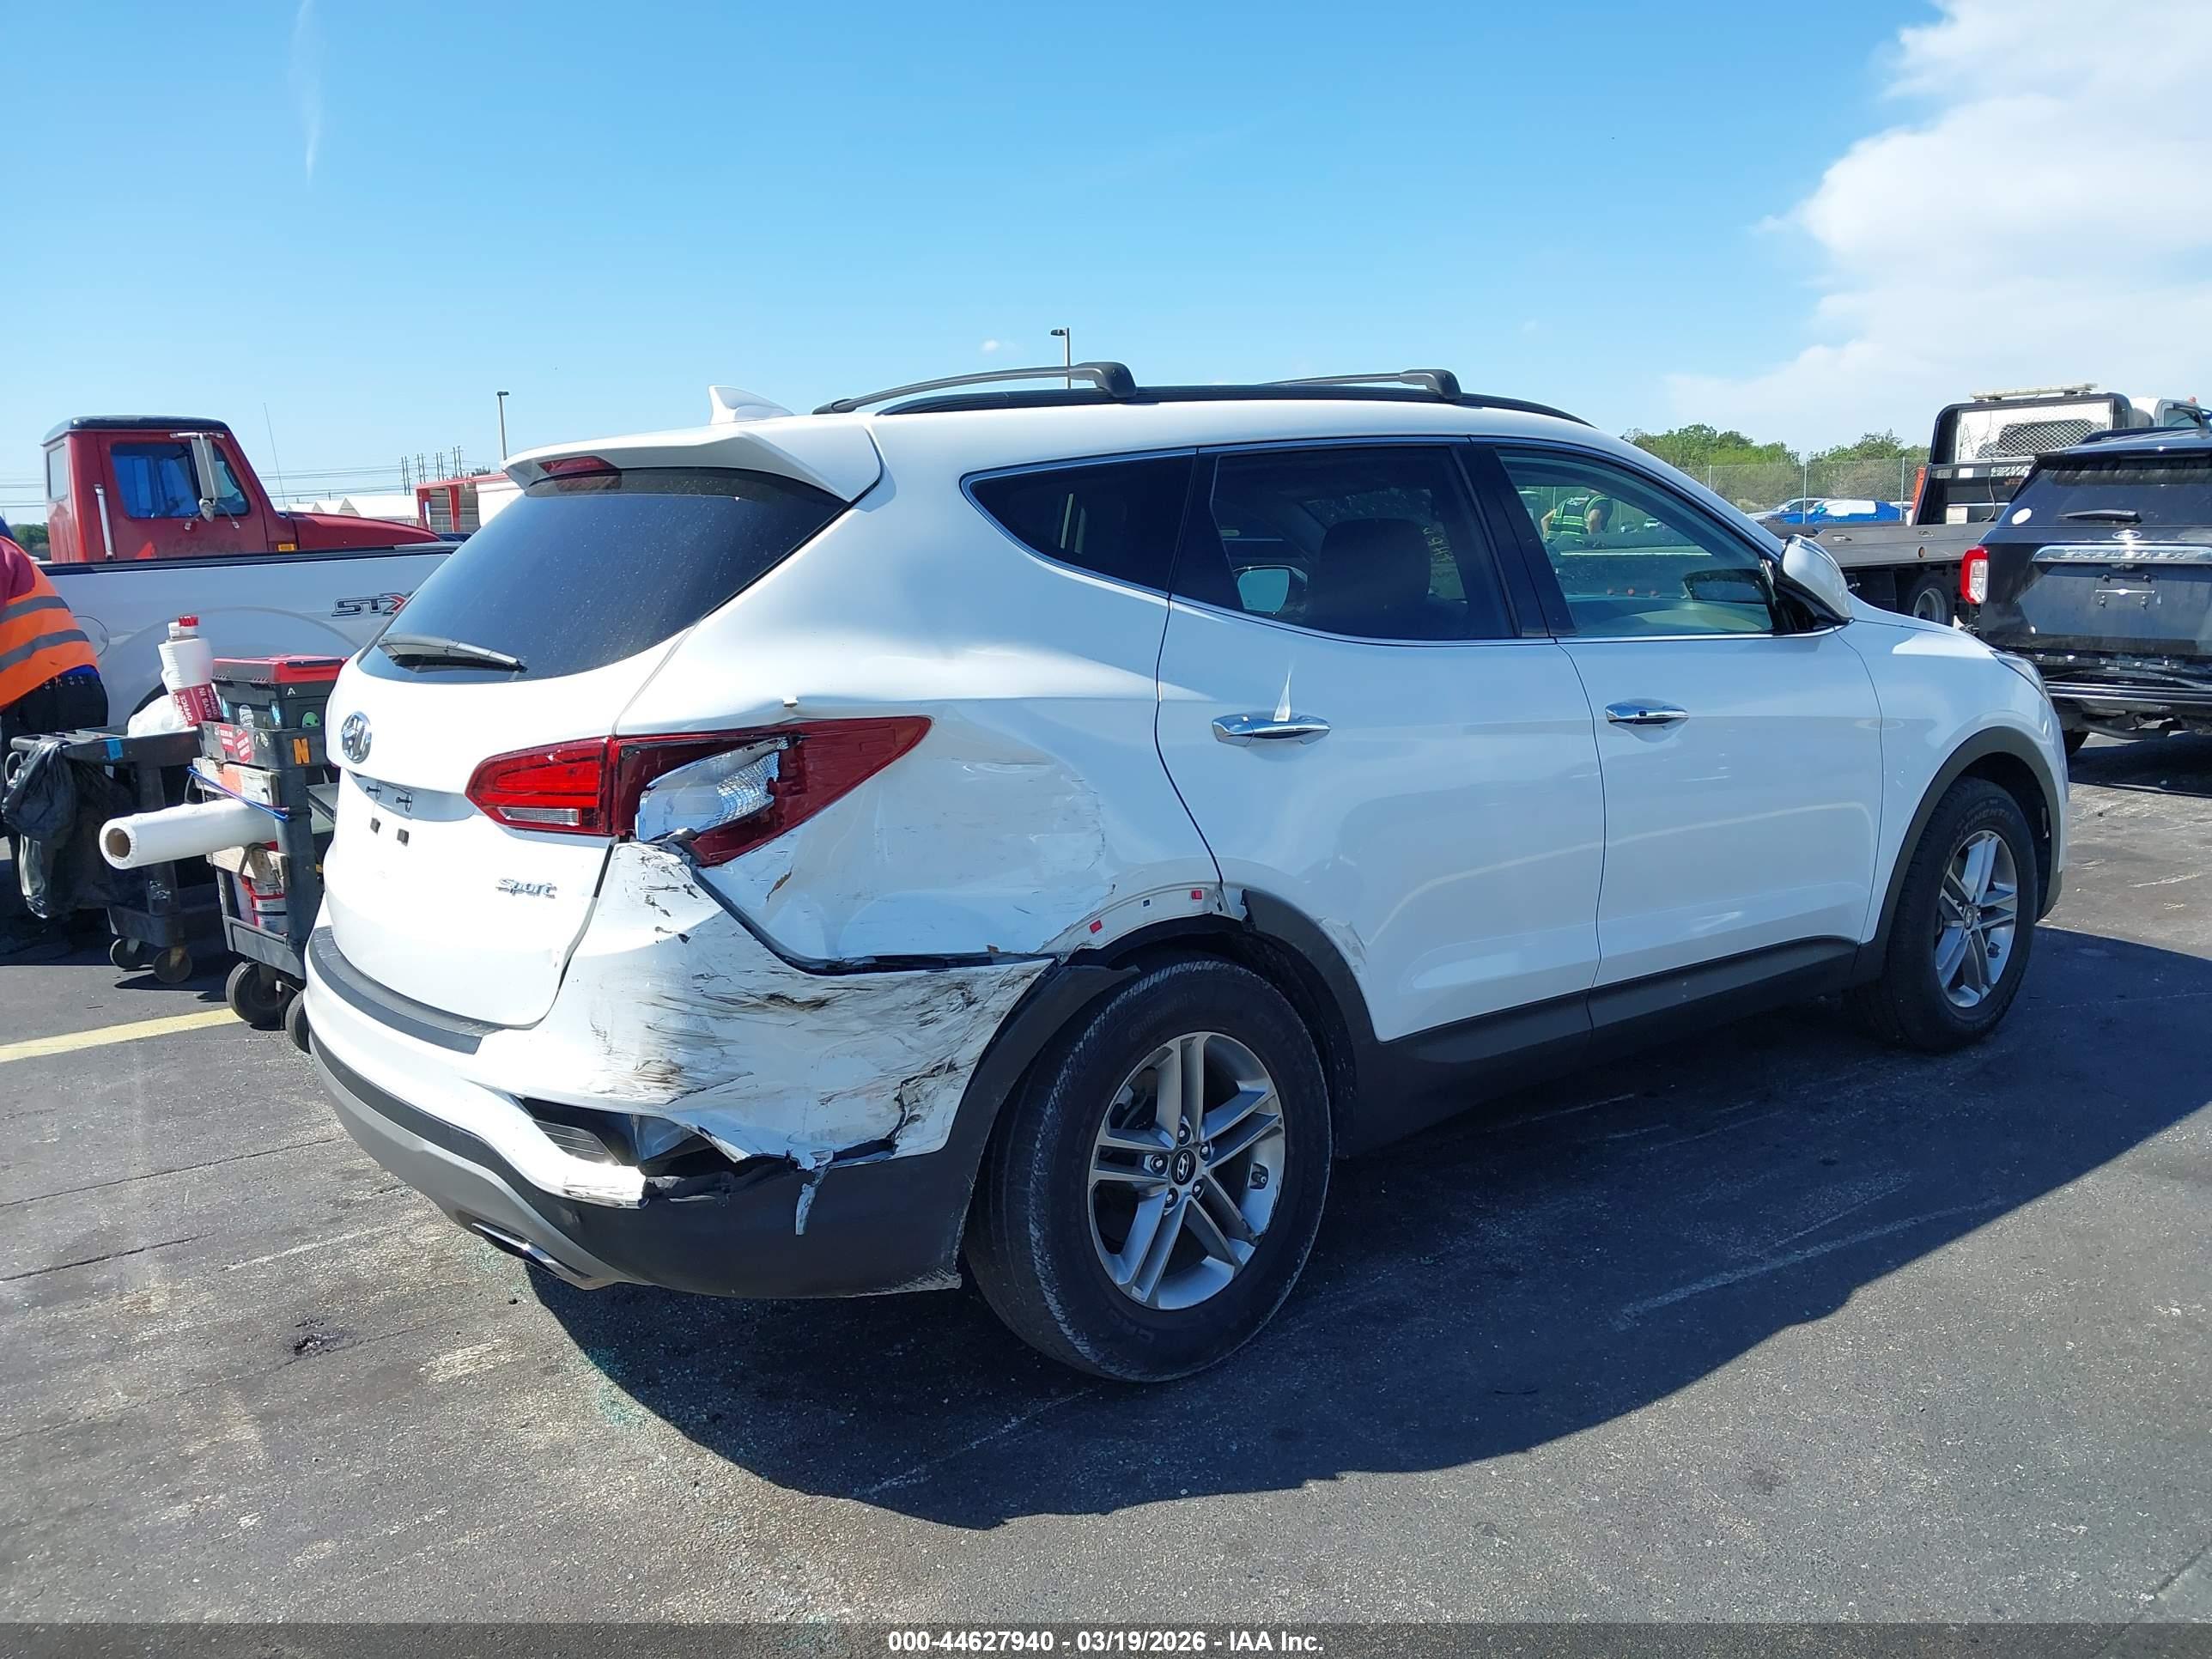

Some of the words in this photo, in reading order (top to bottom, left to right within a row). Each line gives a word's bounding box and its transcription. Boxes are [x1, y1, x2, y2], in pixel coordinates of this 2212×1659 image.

[2061, 550, 2186, 559] EXPLORER
[331, 592, 413, 617] STX
[179, 695, 193, 721] OFFICE
[293, 738, 310, 764] N
[495, 878, 557, 899] Sport
